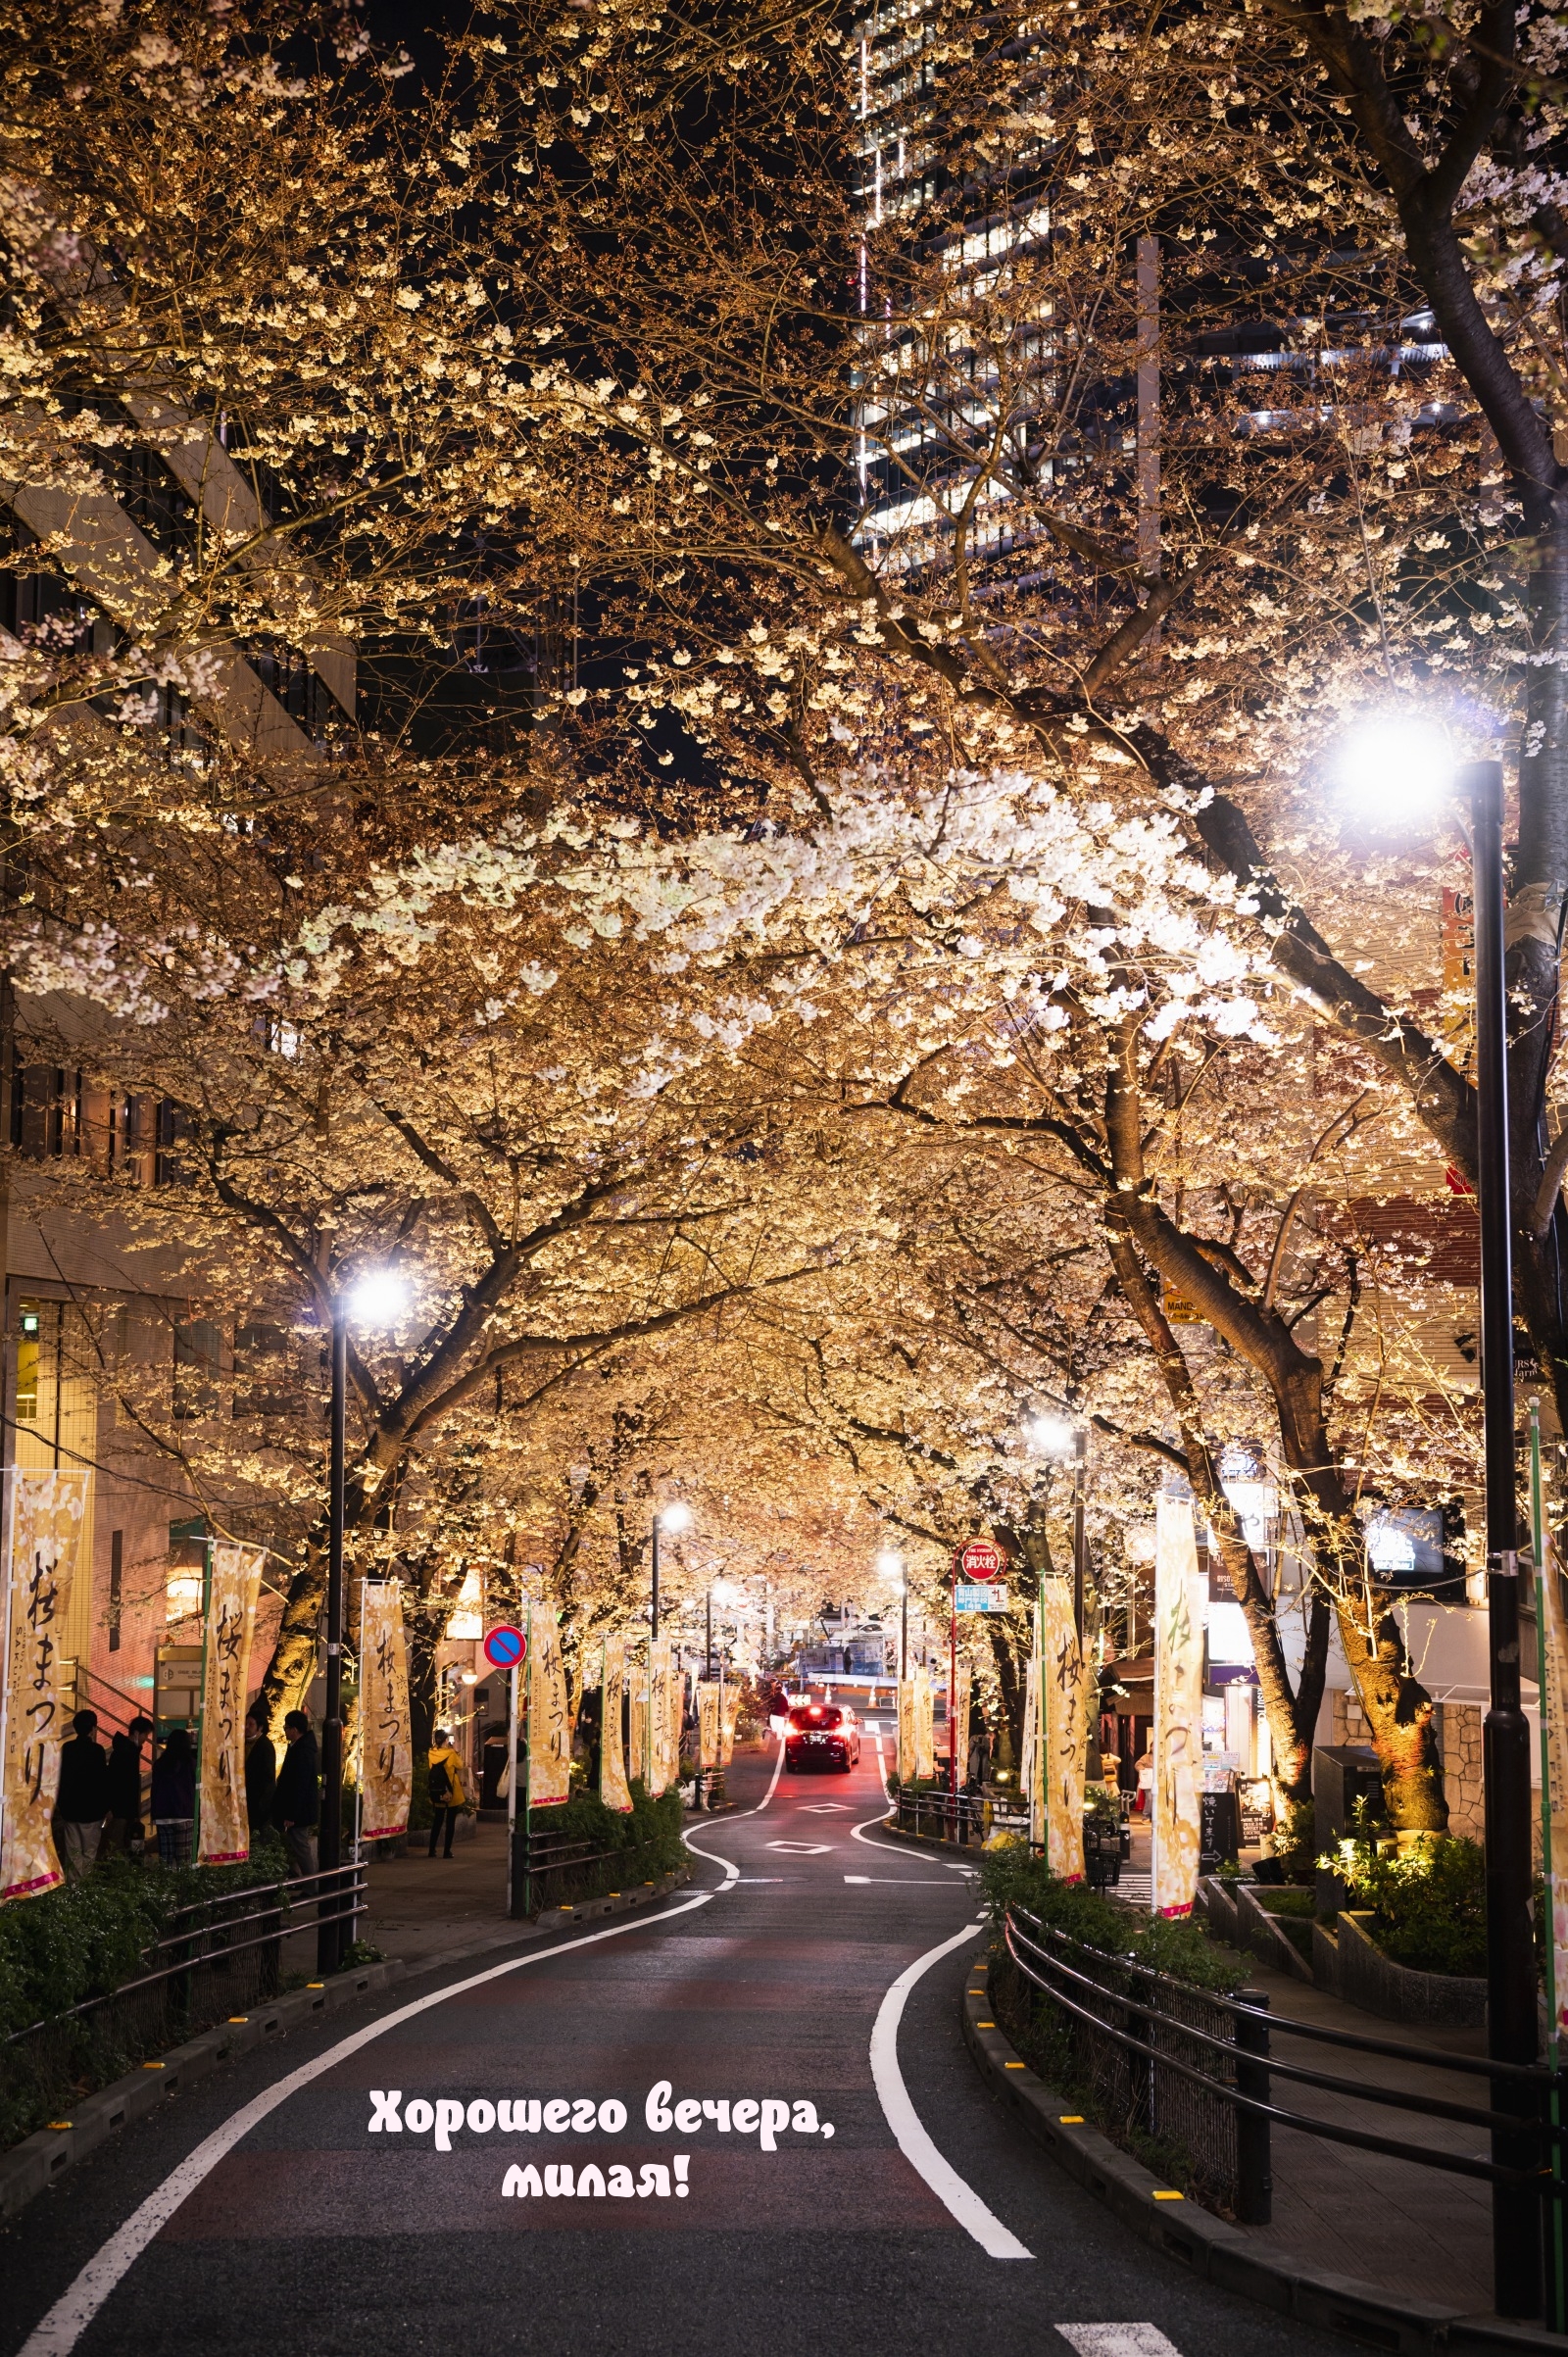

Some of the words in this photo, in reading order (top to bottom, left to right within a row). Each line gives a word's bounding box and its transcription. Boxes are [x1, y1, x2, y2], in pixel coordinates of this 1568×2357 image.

[966, 1555, 996, 1569] 消火栓
[217, 1603, 243, 1796] 桜まつり
[377, 1629, 401, 1784] 桜まつり
[541, 1640, 564, 1762] 桜まつり
[1202, 1796, 1217, 1848] 焼いてます
